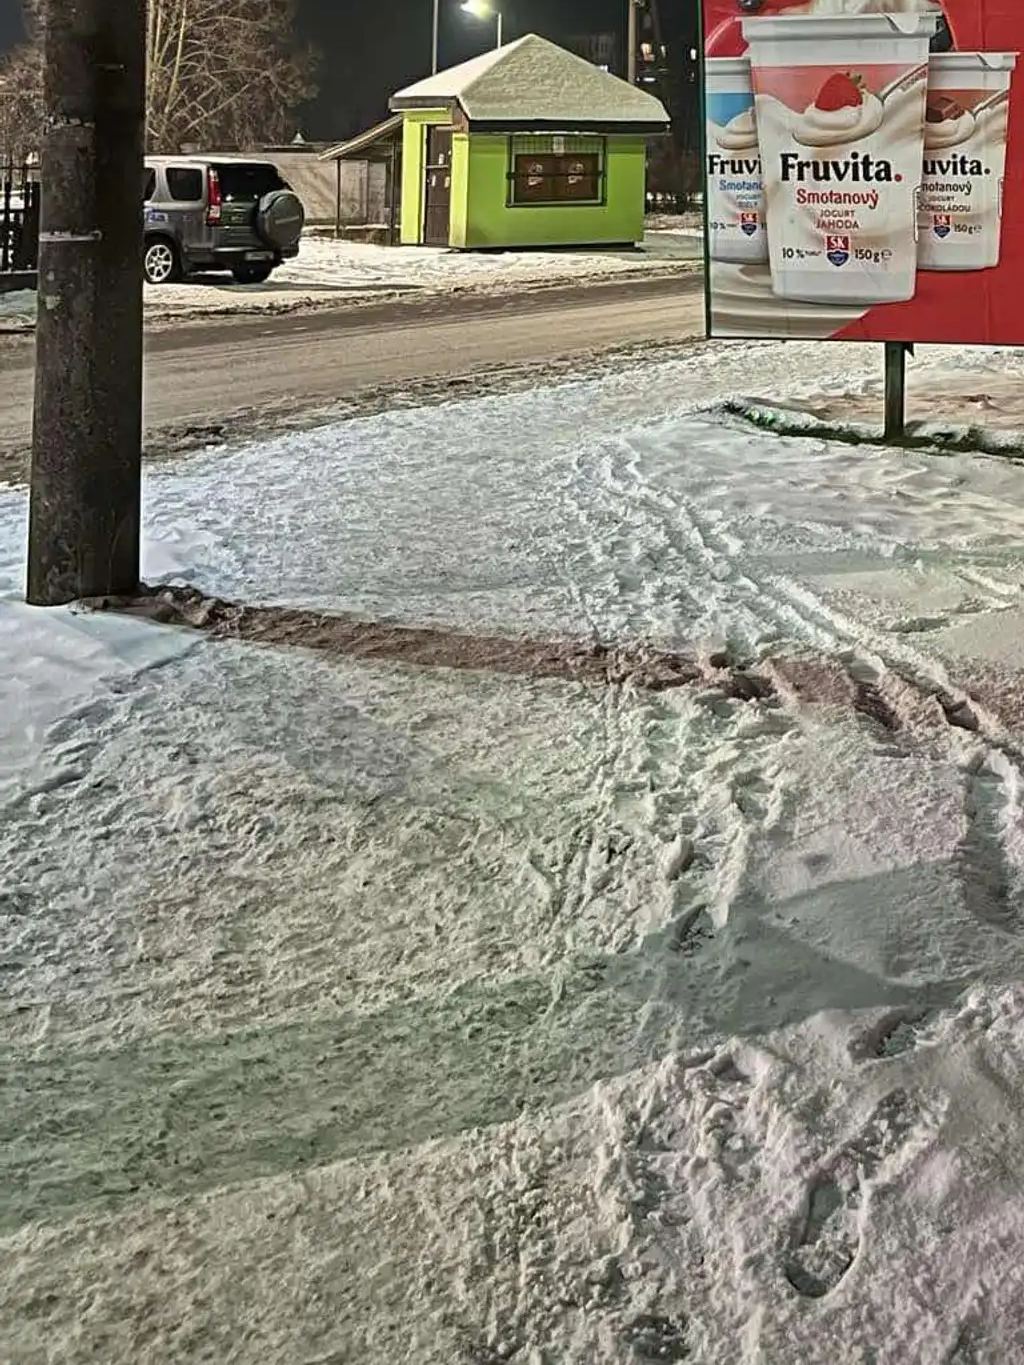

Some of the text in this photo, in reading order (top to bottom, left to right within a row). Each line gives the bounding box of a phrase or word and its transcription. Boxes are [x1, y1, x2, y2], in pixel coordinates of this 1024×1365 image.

[796, 188, 879, 209] Smotanový
[820, 209, 856, 218] JOGURT
[816, 219, 860, 230] JAHODA
[830, 236, 847, 248] SK
[782, 248, 794, 258] 10
